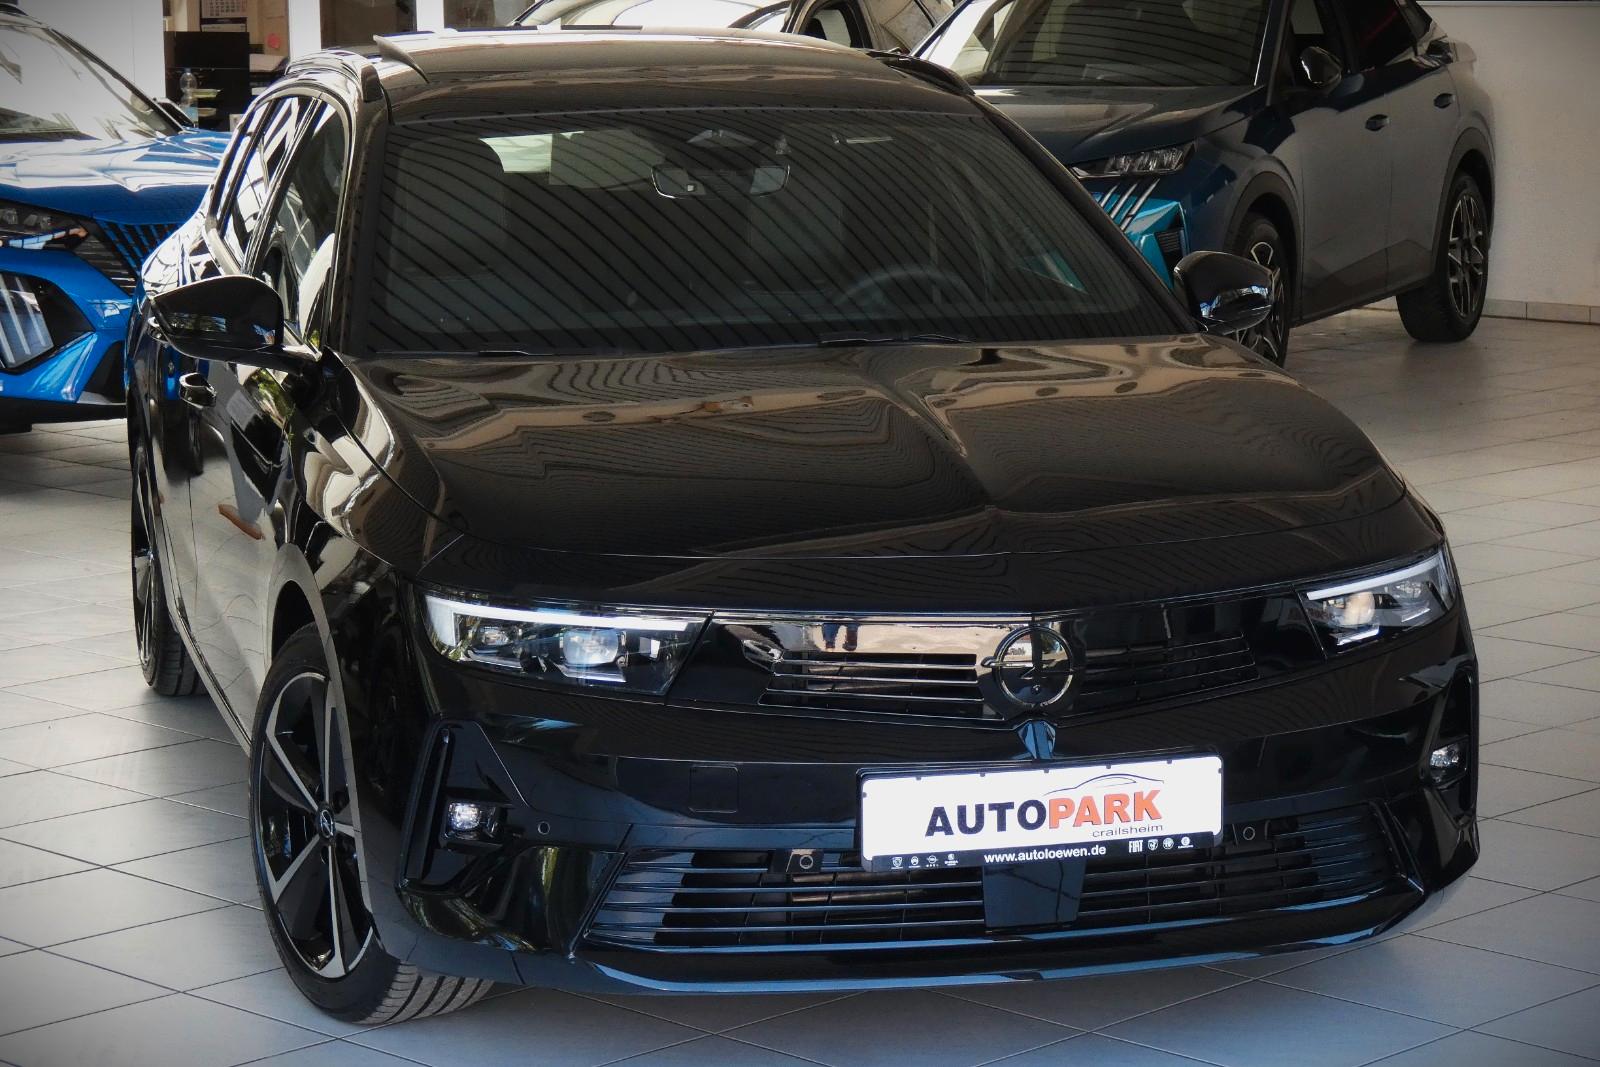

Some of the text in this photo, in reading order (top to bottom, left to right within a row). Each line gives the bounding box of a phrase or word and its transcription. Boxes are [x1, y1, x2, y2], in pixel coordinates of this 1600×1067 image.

[925, 790, 1162, 837] AUTOPARK
[1092, 824, 1163, 839] crailsheim
[984, 845, 1107, 863] www.autoloewen.de
